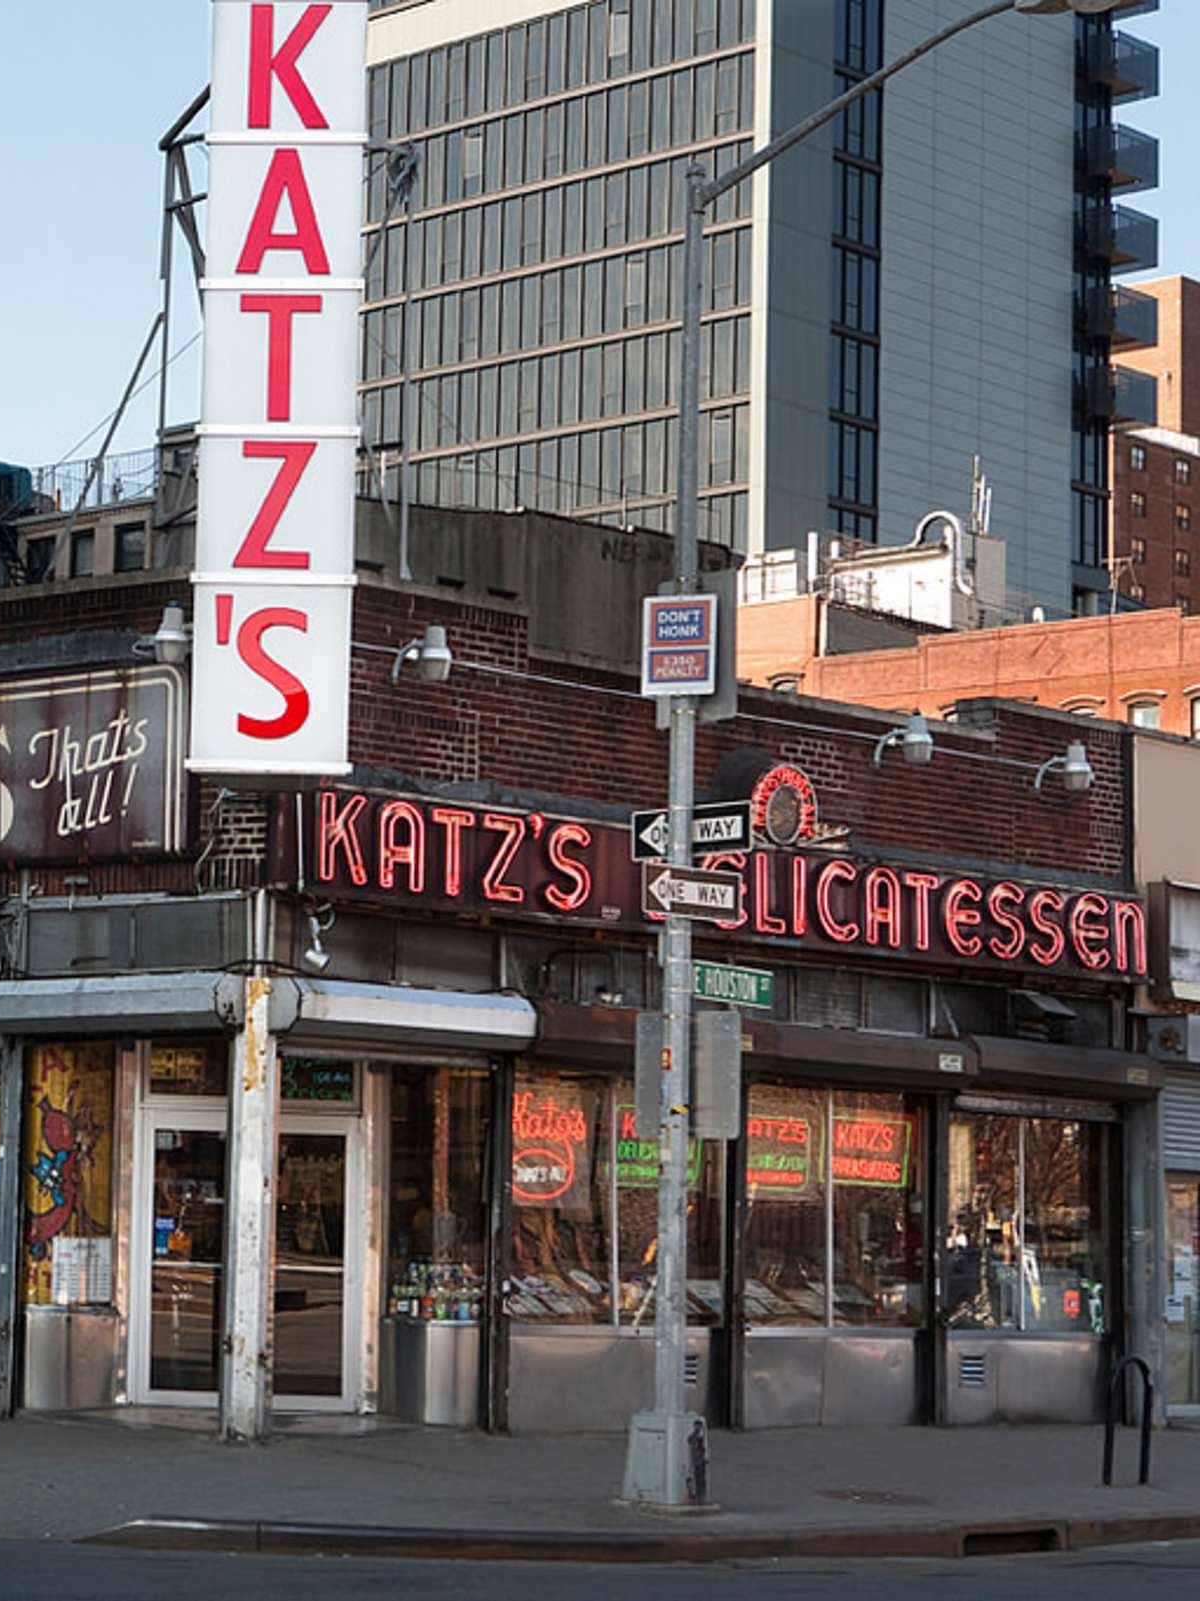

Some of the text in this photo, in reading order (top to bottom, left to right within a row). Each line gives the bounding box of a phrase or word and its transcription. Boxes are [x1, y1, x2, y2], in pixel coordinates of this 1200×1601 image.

[215, 4, 333, 739] KATZ'S
[657, 609, 701, 624] DON'T
[657, 624, 699, 638] HONK
[29, 708, 148, 789] That's
[699, 818, 736, 839] WAY
[319, 791, 591, 911] KATZ'S
[657, 881, 729, 906] ONE WAY
[703, 969, 757, 1000] HOUSTON
[747, 1116, 807, 1143] ATZ'S
